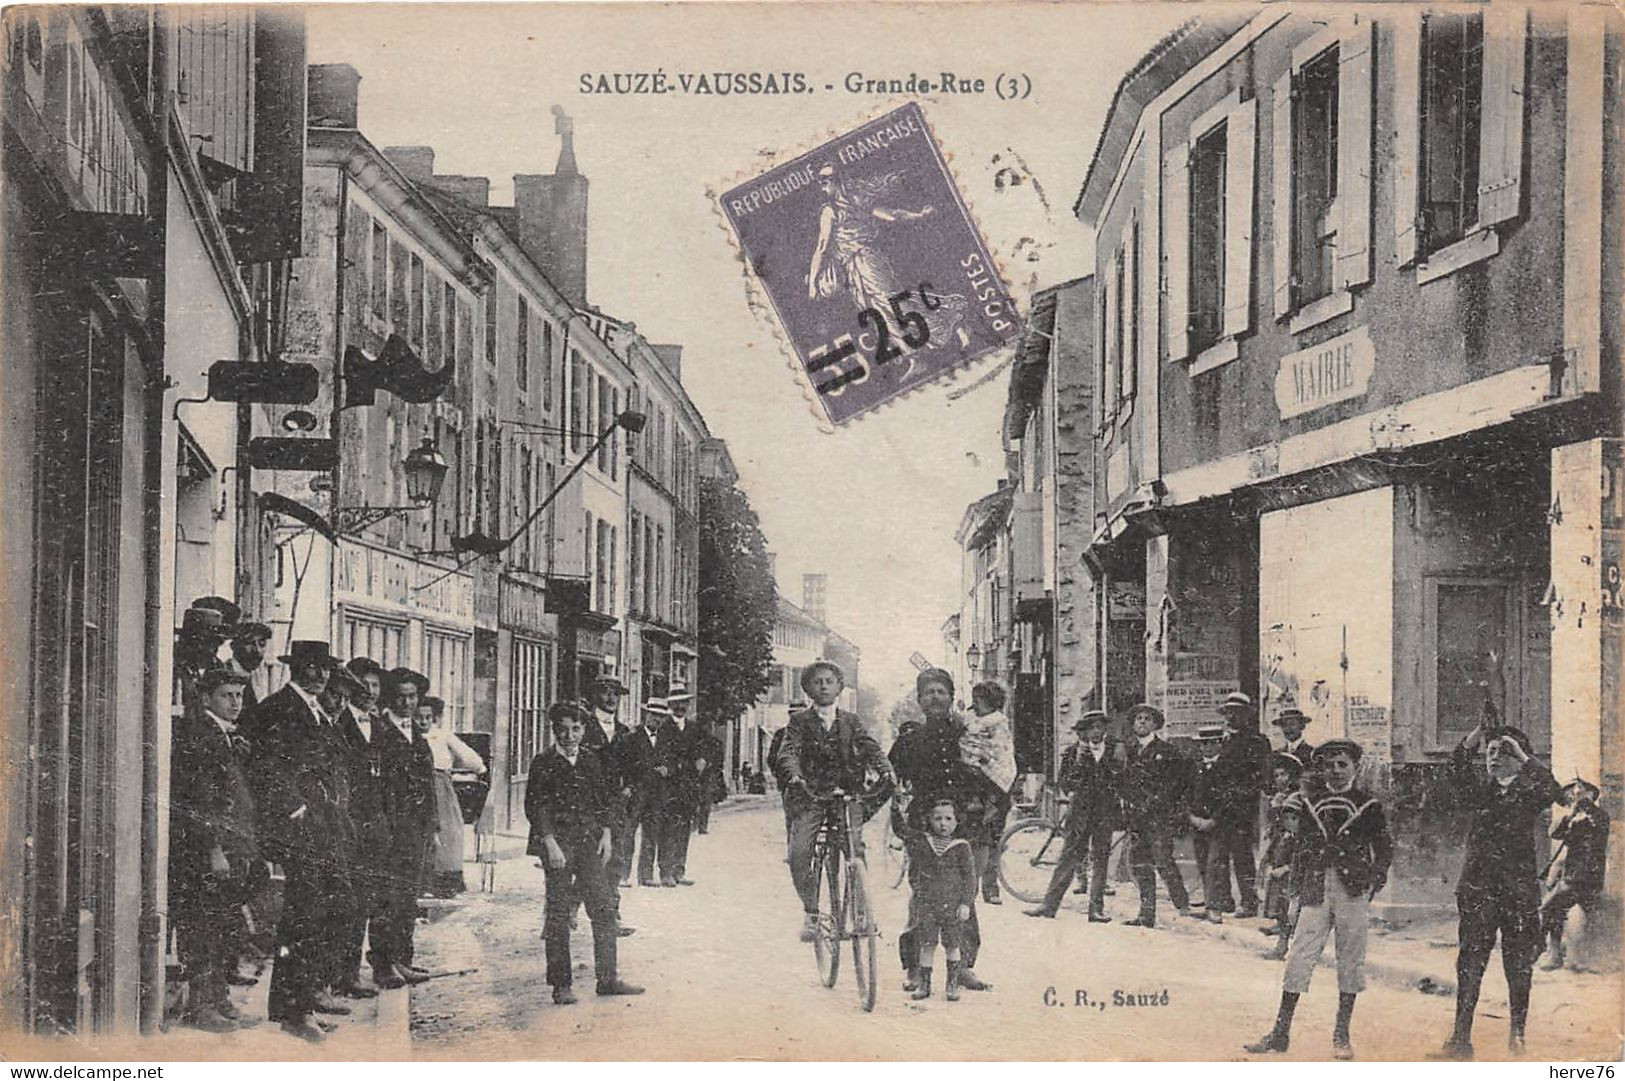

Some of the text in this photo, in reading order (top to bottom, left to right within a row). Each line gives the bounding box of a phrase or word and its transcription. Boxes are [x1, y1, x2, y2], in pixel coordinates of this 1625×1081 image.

[844, 72, 985, 94] Grande-Rue
[995, 73, 1033, 99] (3)
[960, 253, 1011, 331] POSTES
[1293, 342, 1354, 405] MAIRIE
[1043, 986, 1170, 1012] C. R., Sauzé
